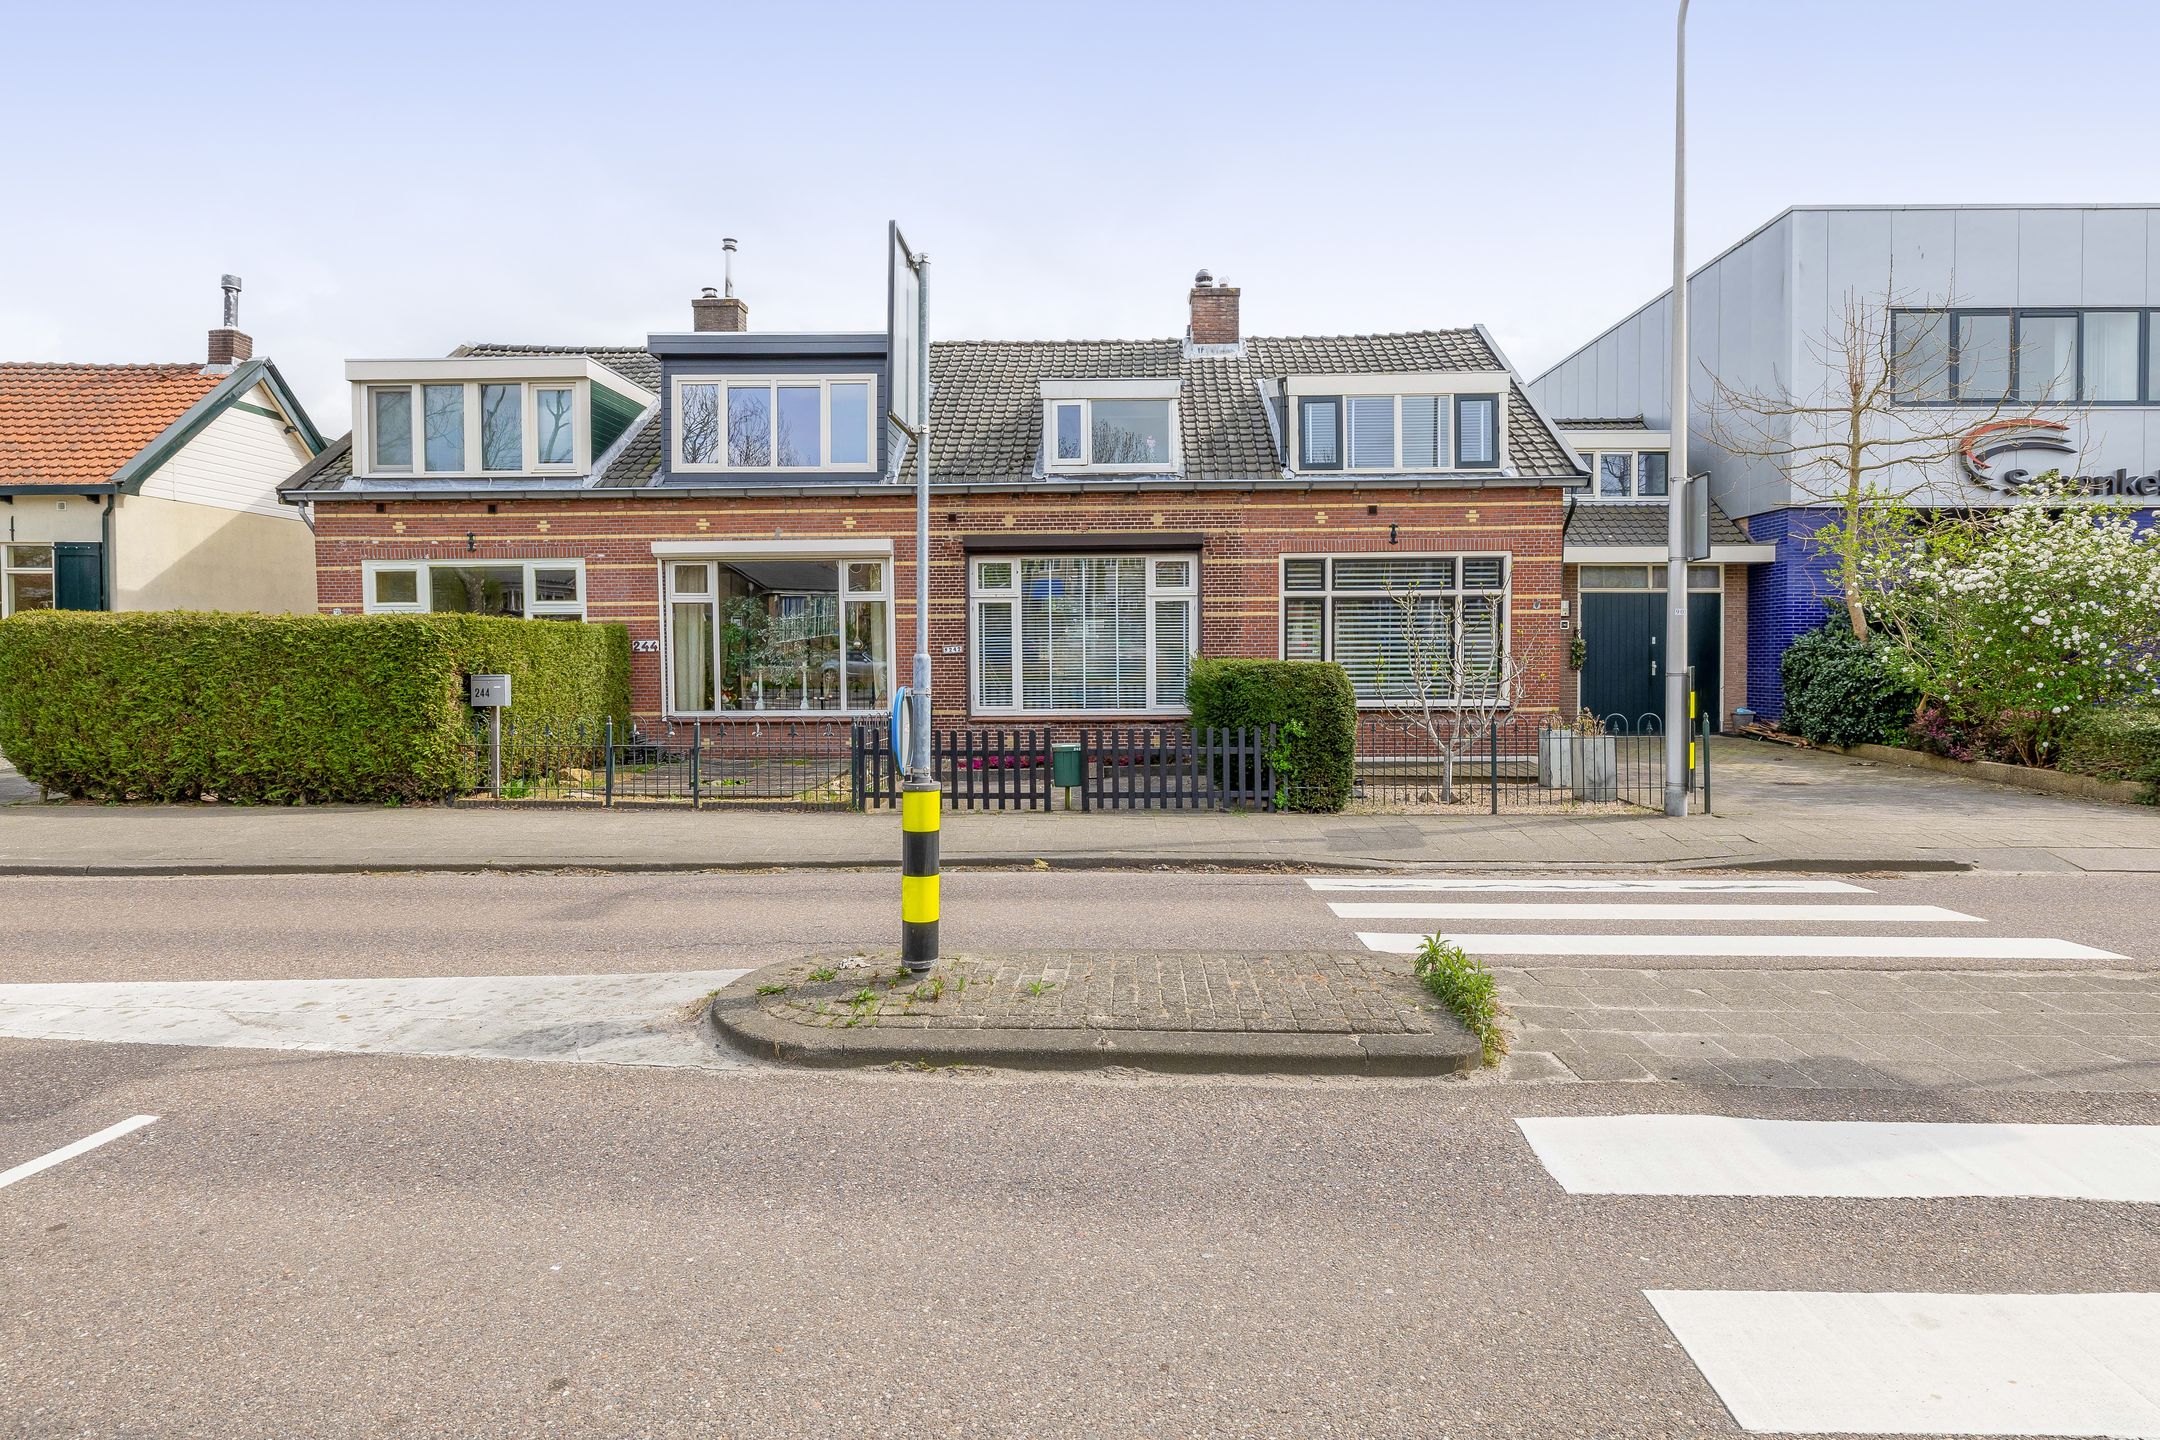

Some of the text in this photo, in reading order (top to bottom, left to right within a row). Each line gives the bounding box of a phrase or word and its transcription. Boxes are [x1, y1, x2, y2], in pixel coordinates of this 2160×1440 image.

[2003, 468, 2160, 497] Senke
[633, 641, 658, 652] 244
[474, 687, 490, 698] 244
